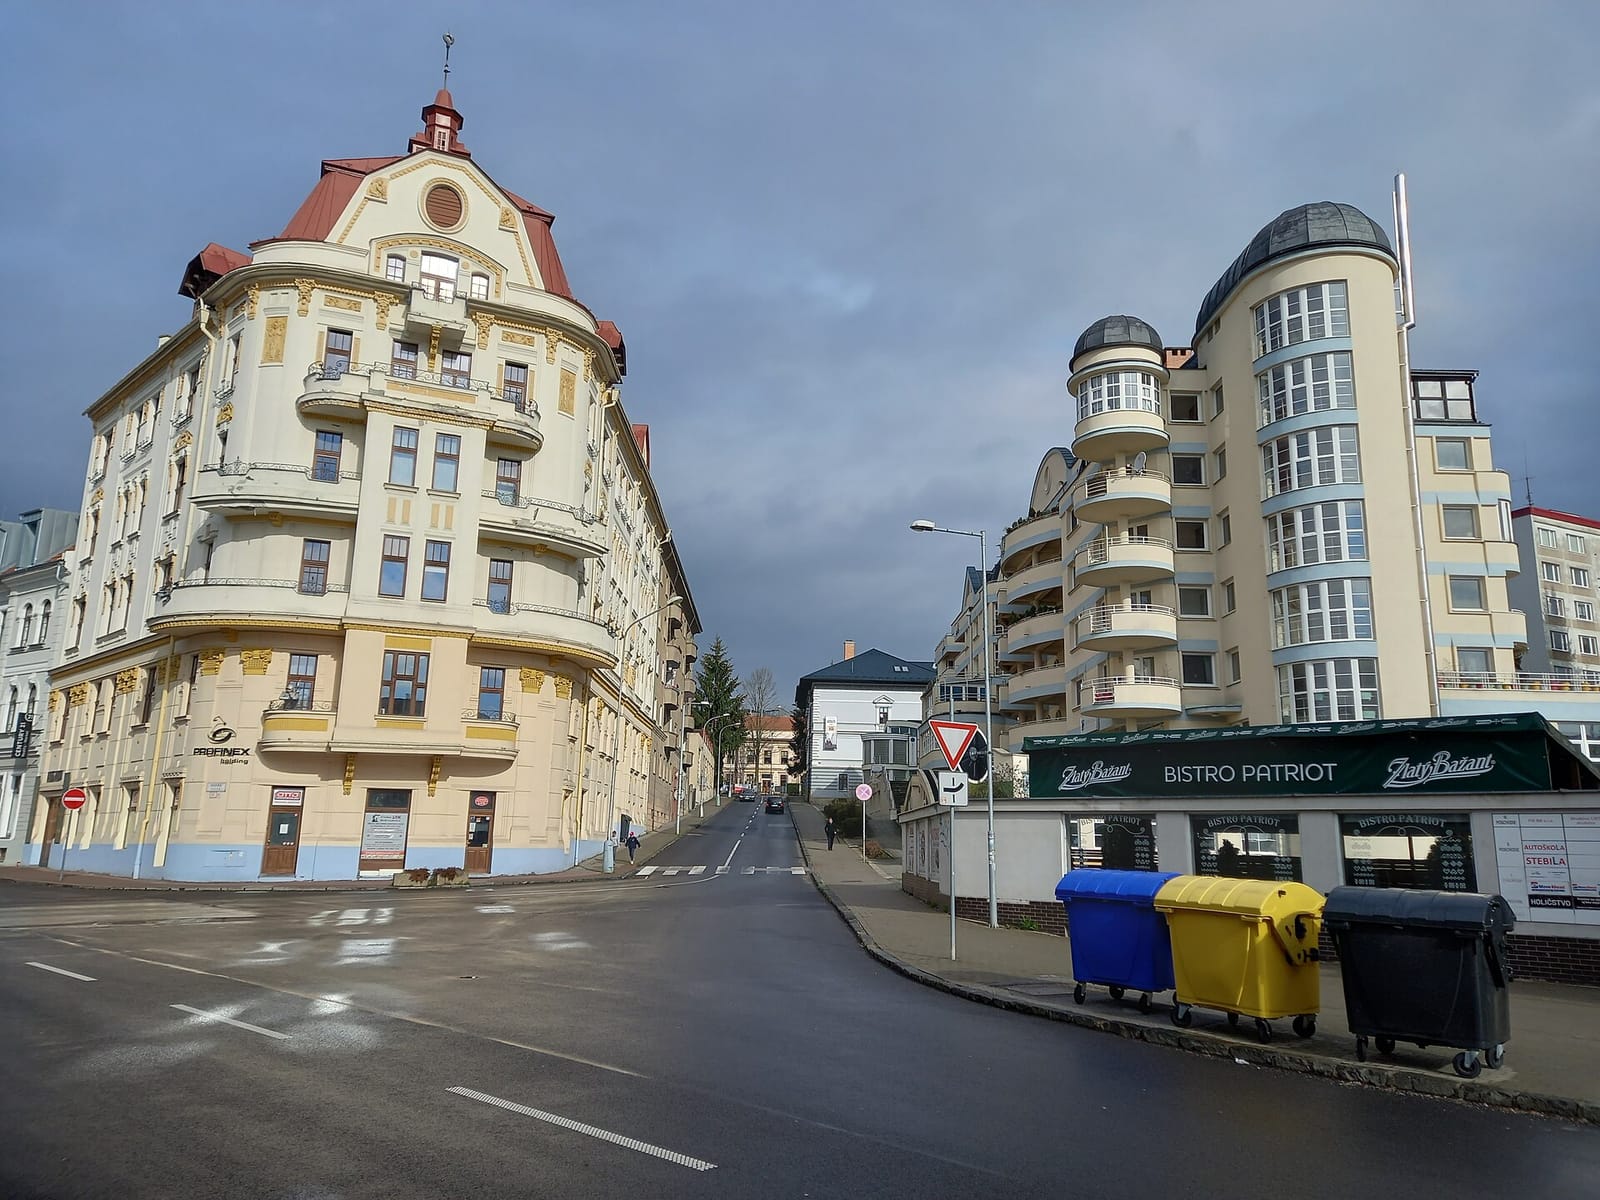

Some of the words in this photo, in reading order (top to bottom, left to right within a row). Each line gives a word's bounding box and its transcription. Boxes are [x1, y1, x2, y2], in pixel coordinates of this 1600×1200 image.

[15, 729, 24, 757] CENTURY
[193, 747, 250, 757] PROFINEX
[1058, 764, 1092, 791] Zlatý
[1089, 760, 1132, 784] Bažant
[1164, 765, 1236, 783] BISTRO
[1242, 763, 1338, 782] PATRIOT
[1382, 757, 1433, 789] Zlatý
[1430, 750, 1495, 781] Bažant
[1108, 814, 1141, 826] PATRIOT
[1207, 815, 1238, 828] BISTRO
[1240, 814, 1281, 828] PATRIOT
[1359, 814, 1397, 829] BISTRO
[1399, 814, 1448, 828] PATRIOT
[1524, 843, 1565, 851] AUTOŠKOLA
[1526, 856, 1566, 866] STEBILA
[1530, 898, 1571, 907] HOLIČSTVO
